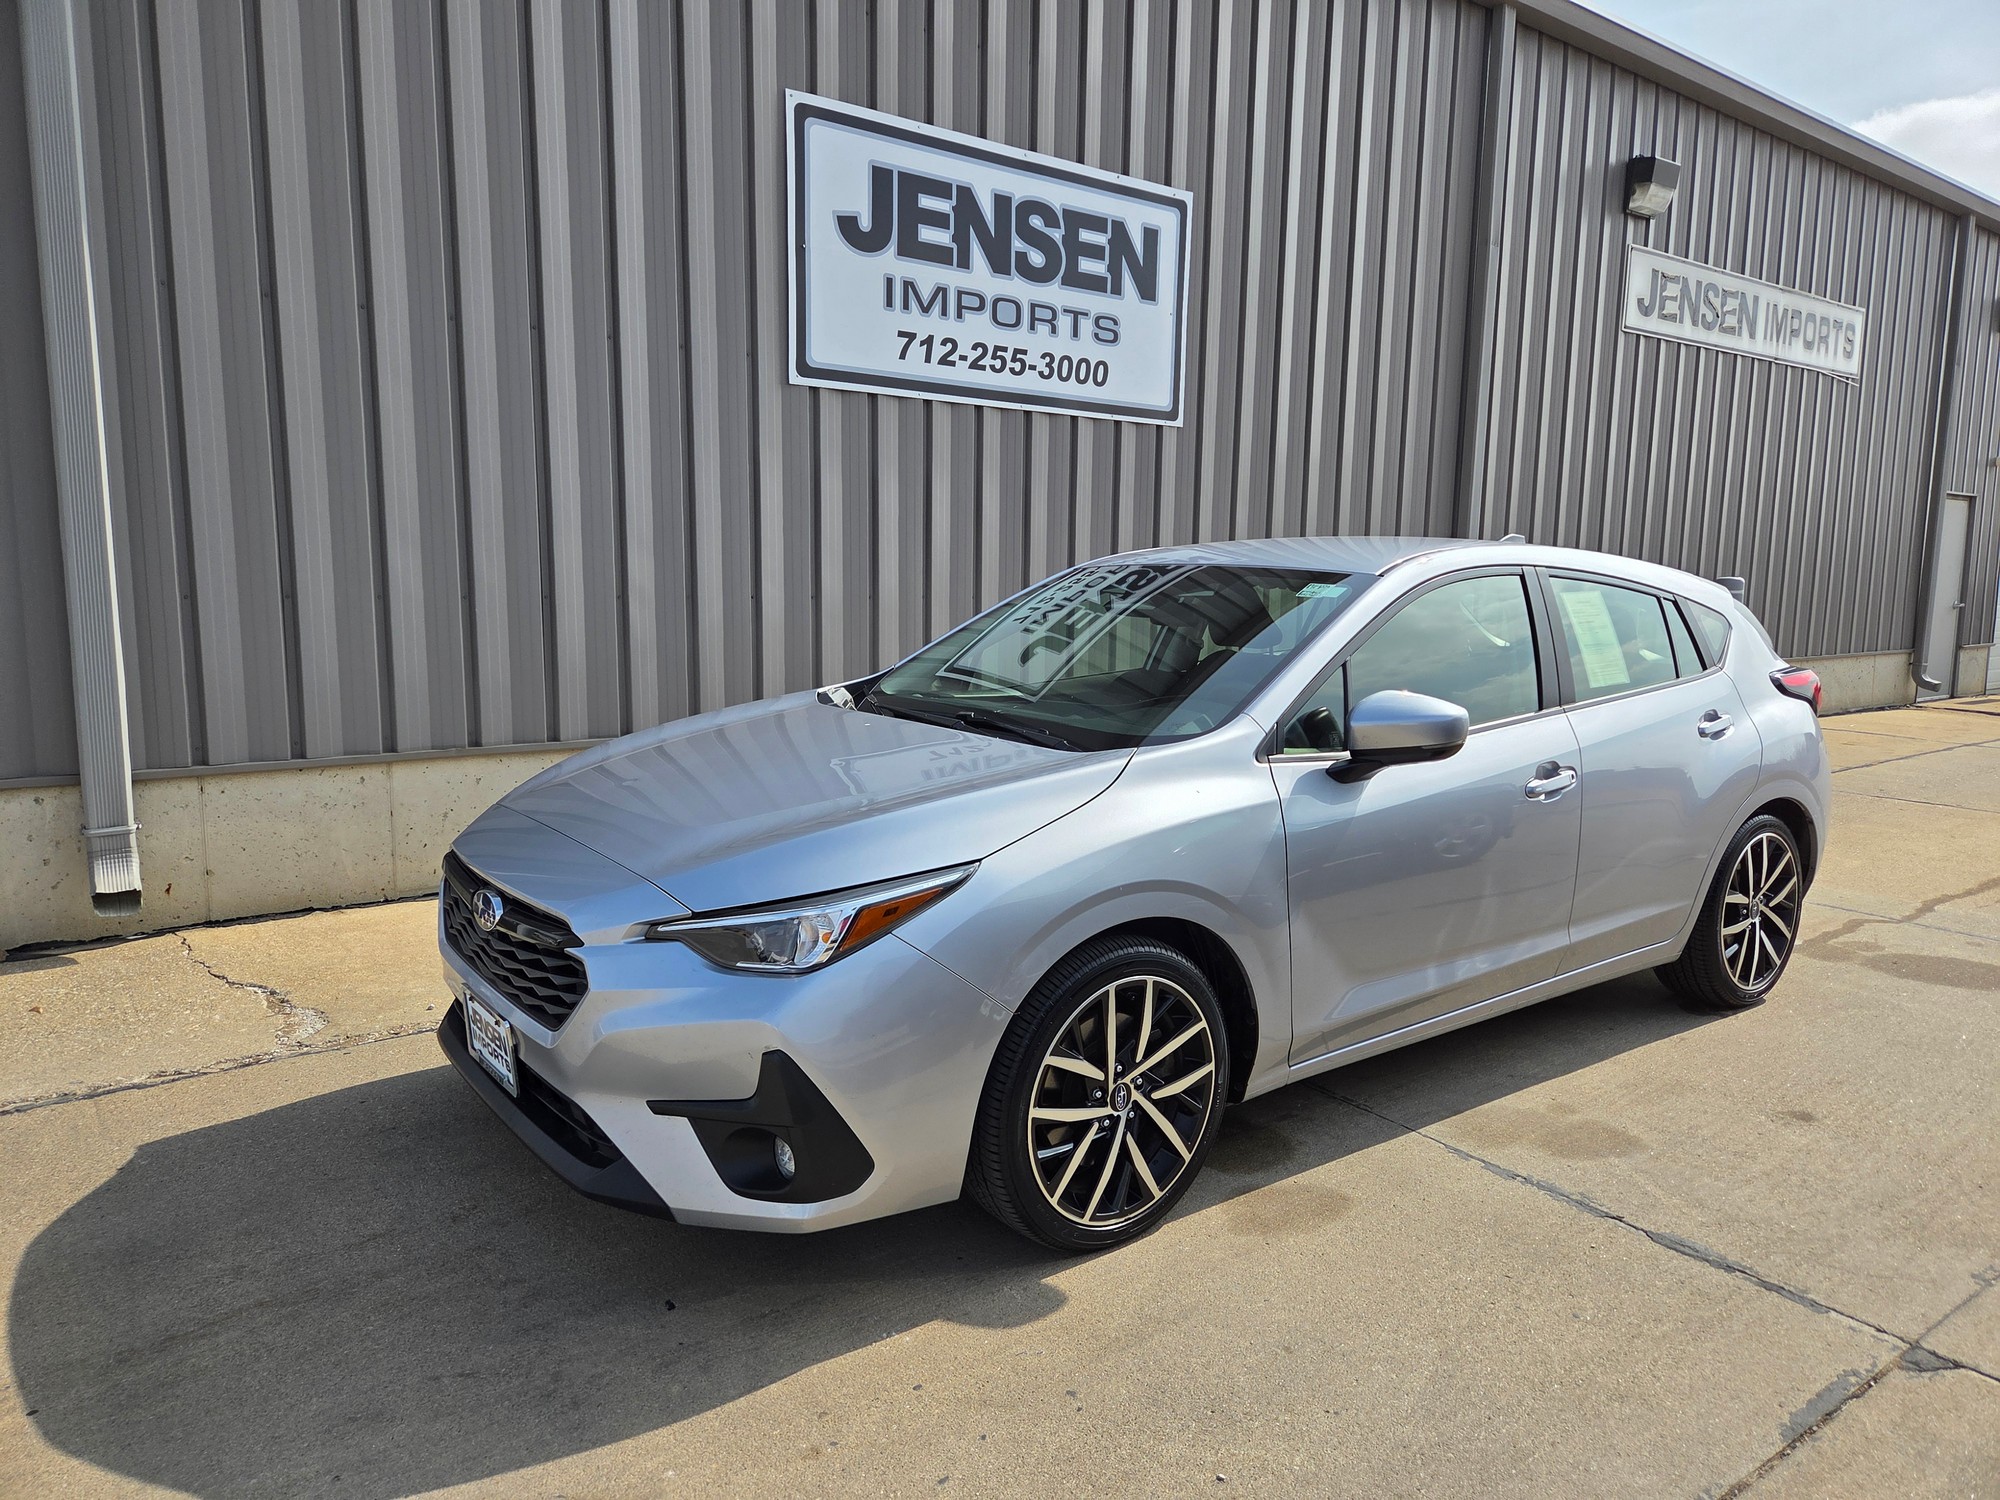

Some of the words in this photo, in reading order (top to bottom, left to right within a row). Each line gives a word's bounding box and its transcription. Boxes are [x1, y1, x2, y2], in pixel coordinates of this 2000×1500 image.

[834, 160, 1160, 305] JENSEN
[884, 274, 1121, 347] IMPORTS
[1637, 268, 1759, 339] JENSEN
[1763, 301, 1856, 360] IMPORTS
[896, 329, 1110, 388] 712-255-3000
